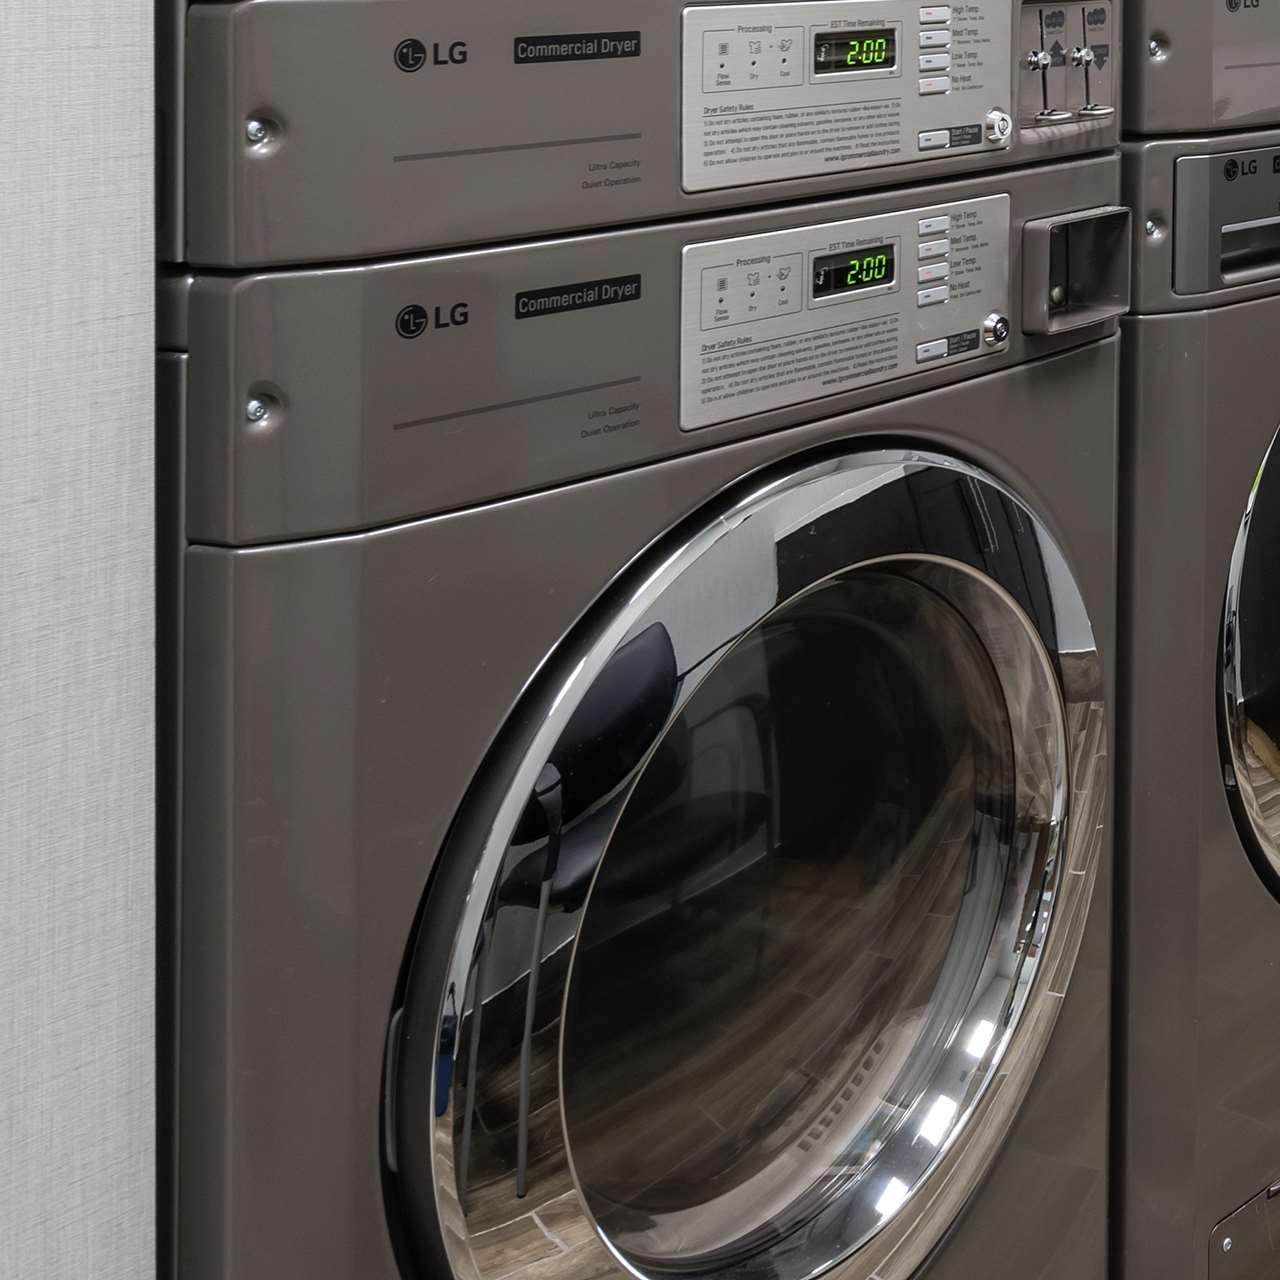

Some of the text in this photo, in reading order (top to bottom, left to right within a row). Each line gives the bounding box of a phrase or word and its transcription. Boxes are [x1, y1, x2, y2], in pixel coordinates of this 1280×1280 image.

[433, 40, 468, 65] LG
[518, 38, 639, 58] Commercial Dryer
[1241, 159, 1258, 176] LG
[519, 281, 639, 314] Commercial Dryer
[435, 302, 469, 328] LG
